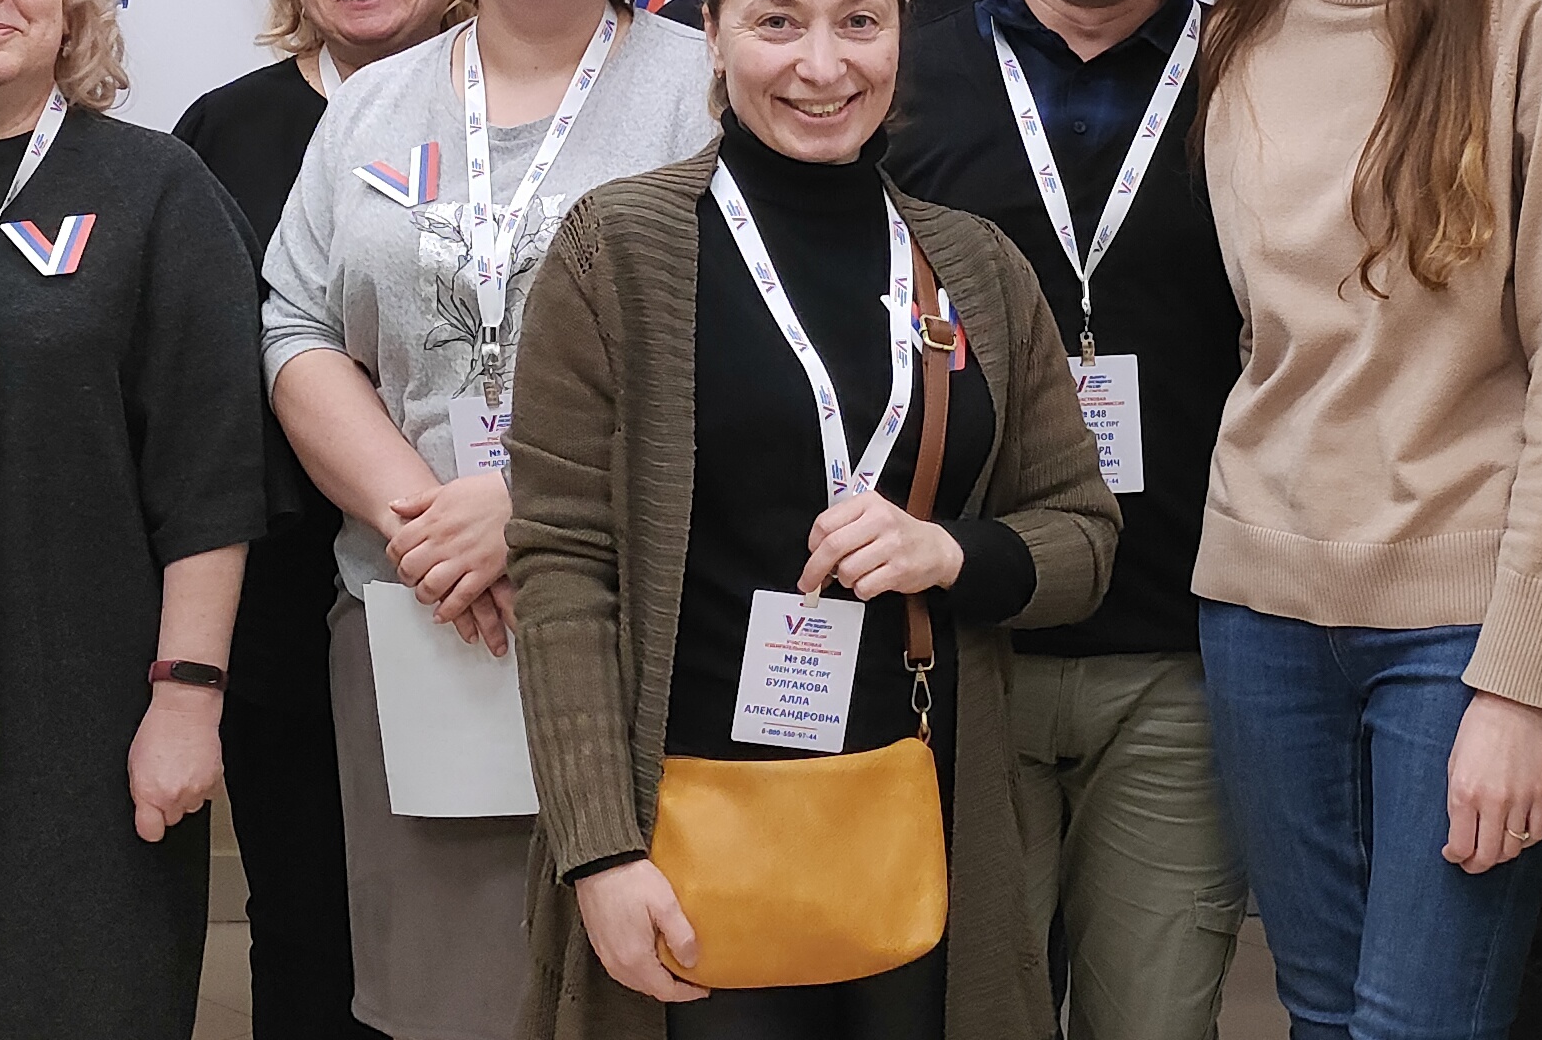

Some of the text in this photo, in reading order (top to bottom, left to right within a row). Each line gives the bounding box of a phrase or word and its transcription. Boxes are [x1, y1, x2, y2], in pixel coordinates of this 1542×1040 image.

[1090, 409, 1107, 418] 848
[784, 653, 820, 667] № 848
[768, 664, 790, 673] ЧЛЕН
[791, 667, 808, 676] УИК
[765, 677, 829, 694] БУЛГАКОВА
[779, 694, 810, 706] АЛЛА
[743, 704, 840, 725] АЛЕКСАНДРОВНА
